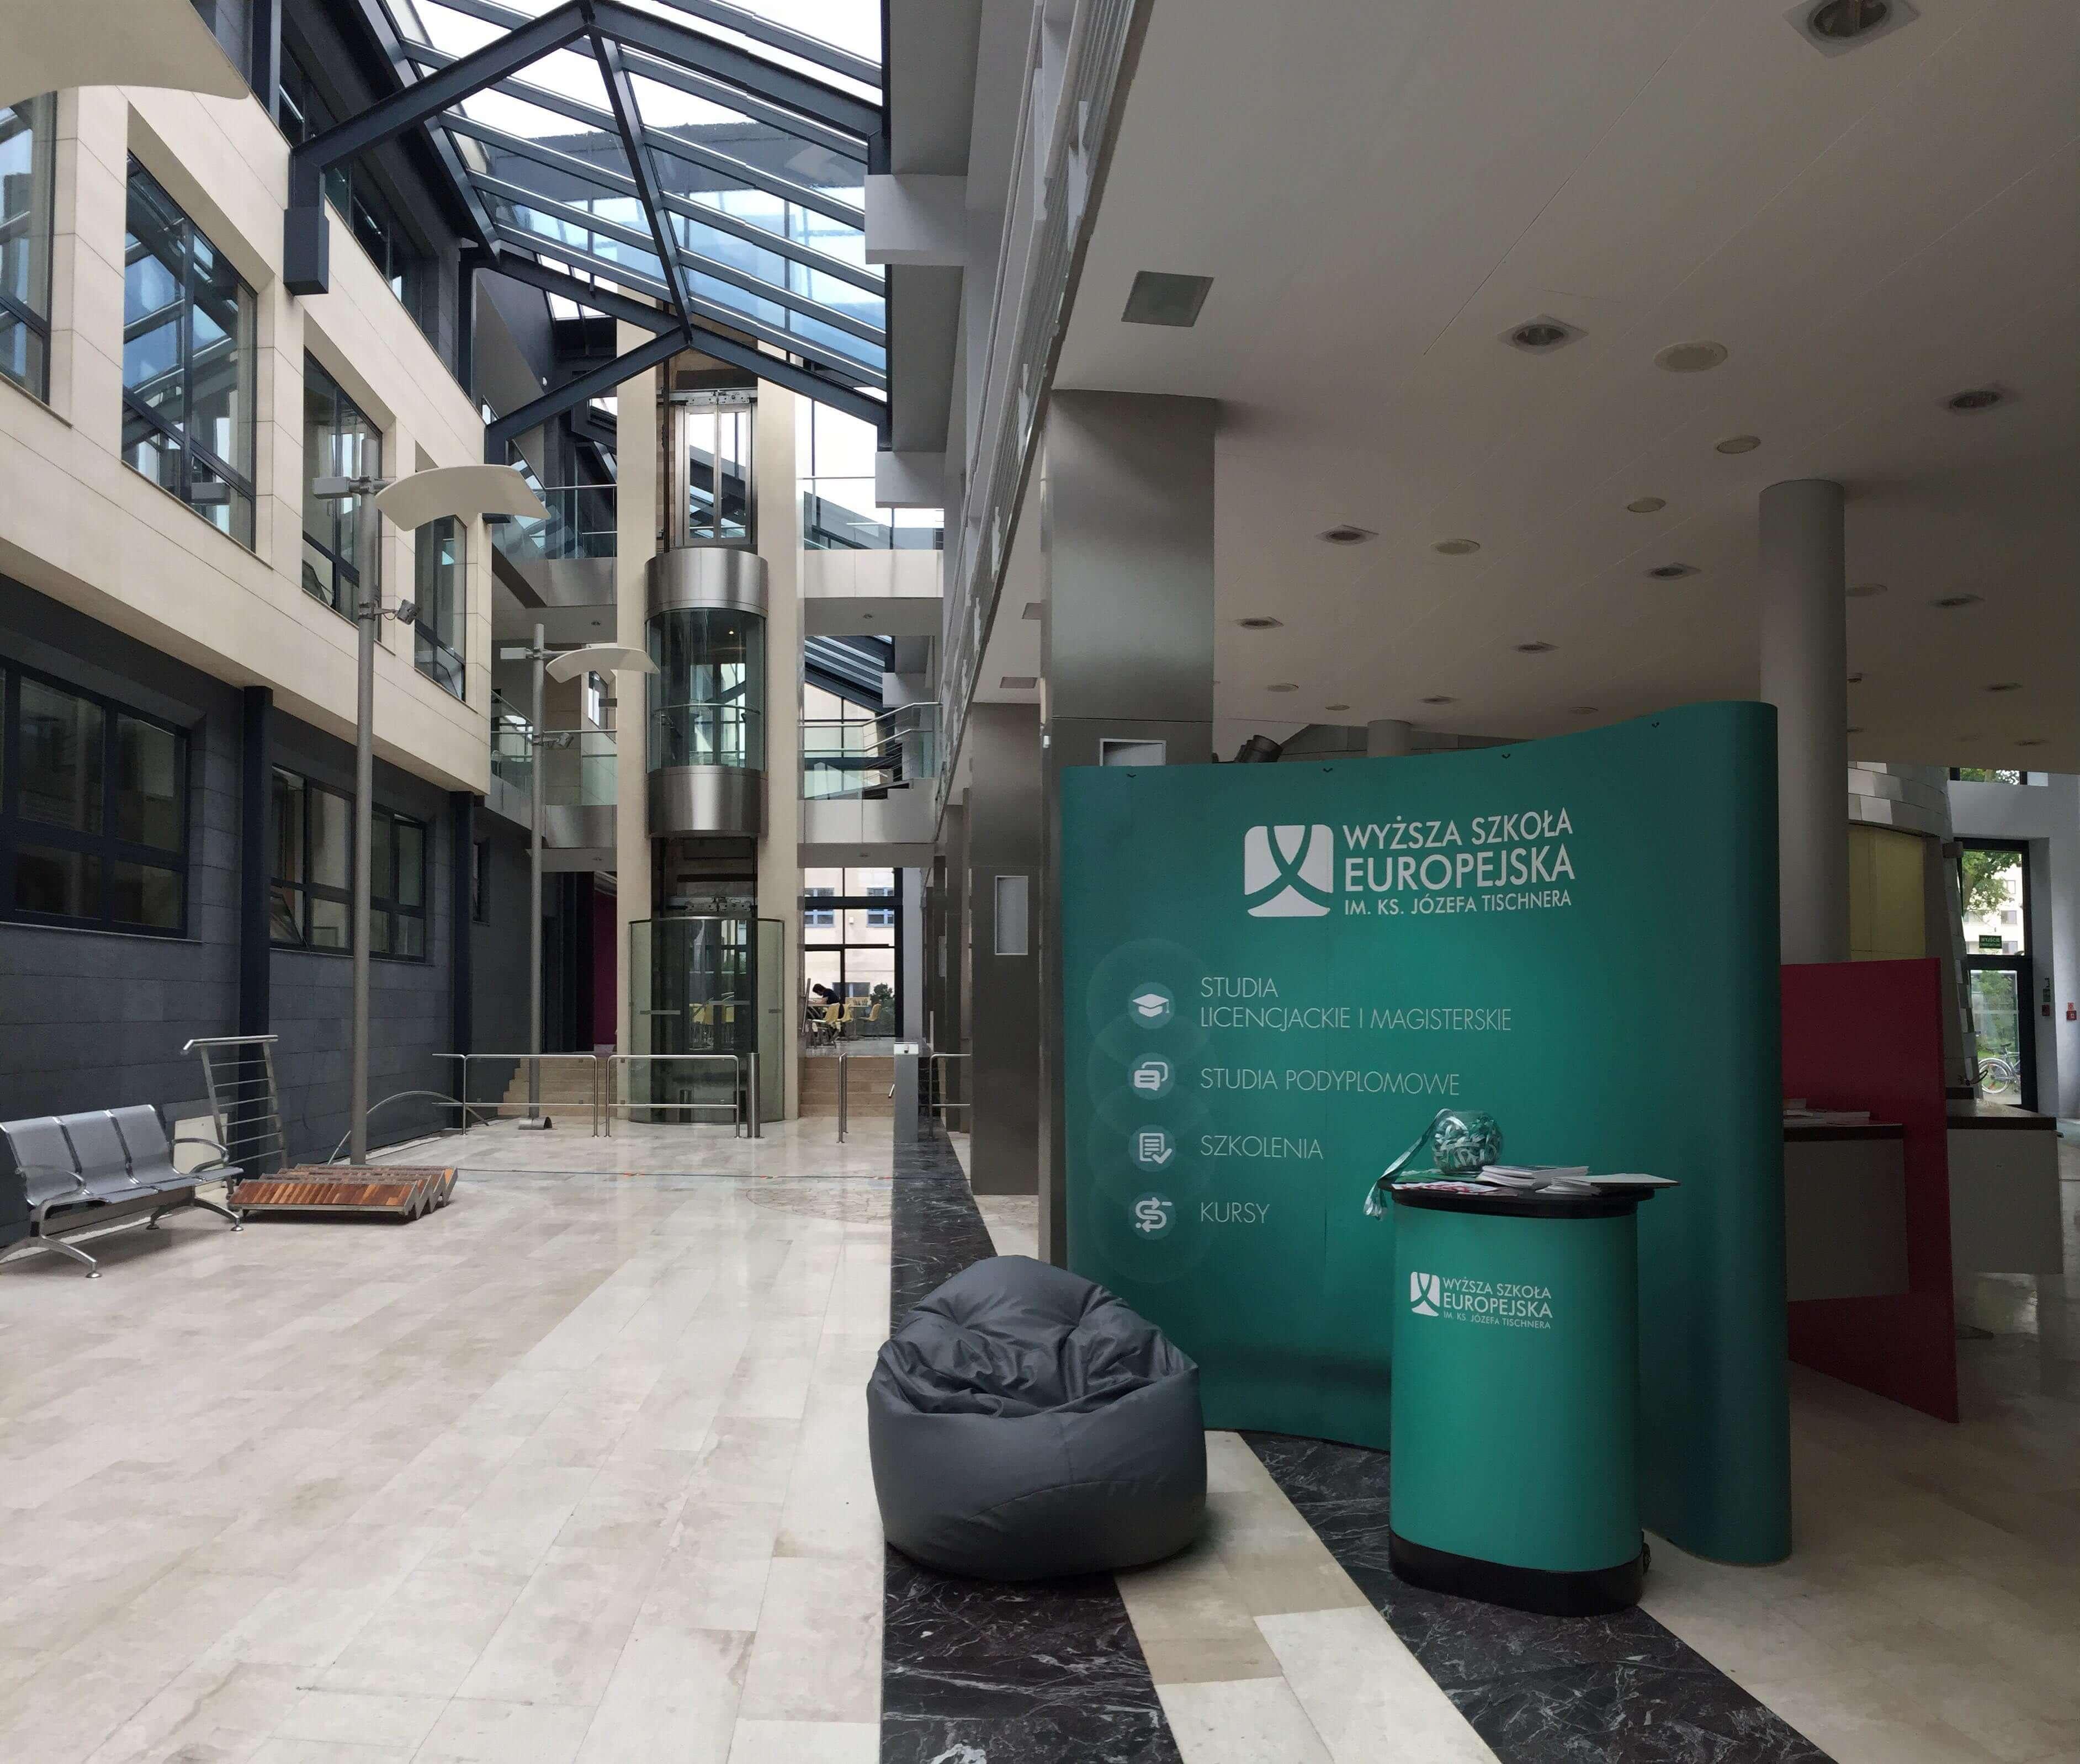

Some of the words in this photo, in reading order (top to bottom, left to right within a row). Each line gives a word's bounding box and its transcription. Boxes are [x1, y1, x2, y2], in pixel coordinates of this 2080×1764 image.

[1343, 815, 1462, 851] WYŻSZA
[1471, 807, 1573, 846] SZKOŁA
[1345, 843, 1575, 892] EUROPEJSKA
[1345, 900, 1371, 915] IM.
[1378, 899, 1404, 915] KS.
[1410, 894, 1477, 915] JÓZEFA
[1482, 889, 1572, 912] TISCHNERA
[1201, 977, 1278, 997] STUDIA
[1201, 1007, 1350, 1032] LICENCJACKIE
[1360, 1008, 1363, 1028] I
[1370, 1008, 1511, 1031] MAGISTERSKIE
[1200, 1068, 1278, 1090] STUDIA
[1286, 1070, 1460, 1096] PODYPLOMOWE
[1200, 1135, 1324, 1160] SZKOLENIA
[1201, 1202, 1270, 1224] KURSY
[1442, 1276, 1493, 1295] WYŻSZA
[1497, 1283, 1552, 1299] SZKOŁA
[1444, 1292, 1553, 1319] EUROPEJSKA
[1502, 1317, 1551, 1330] TISCHNERA
